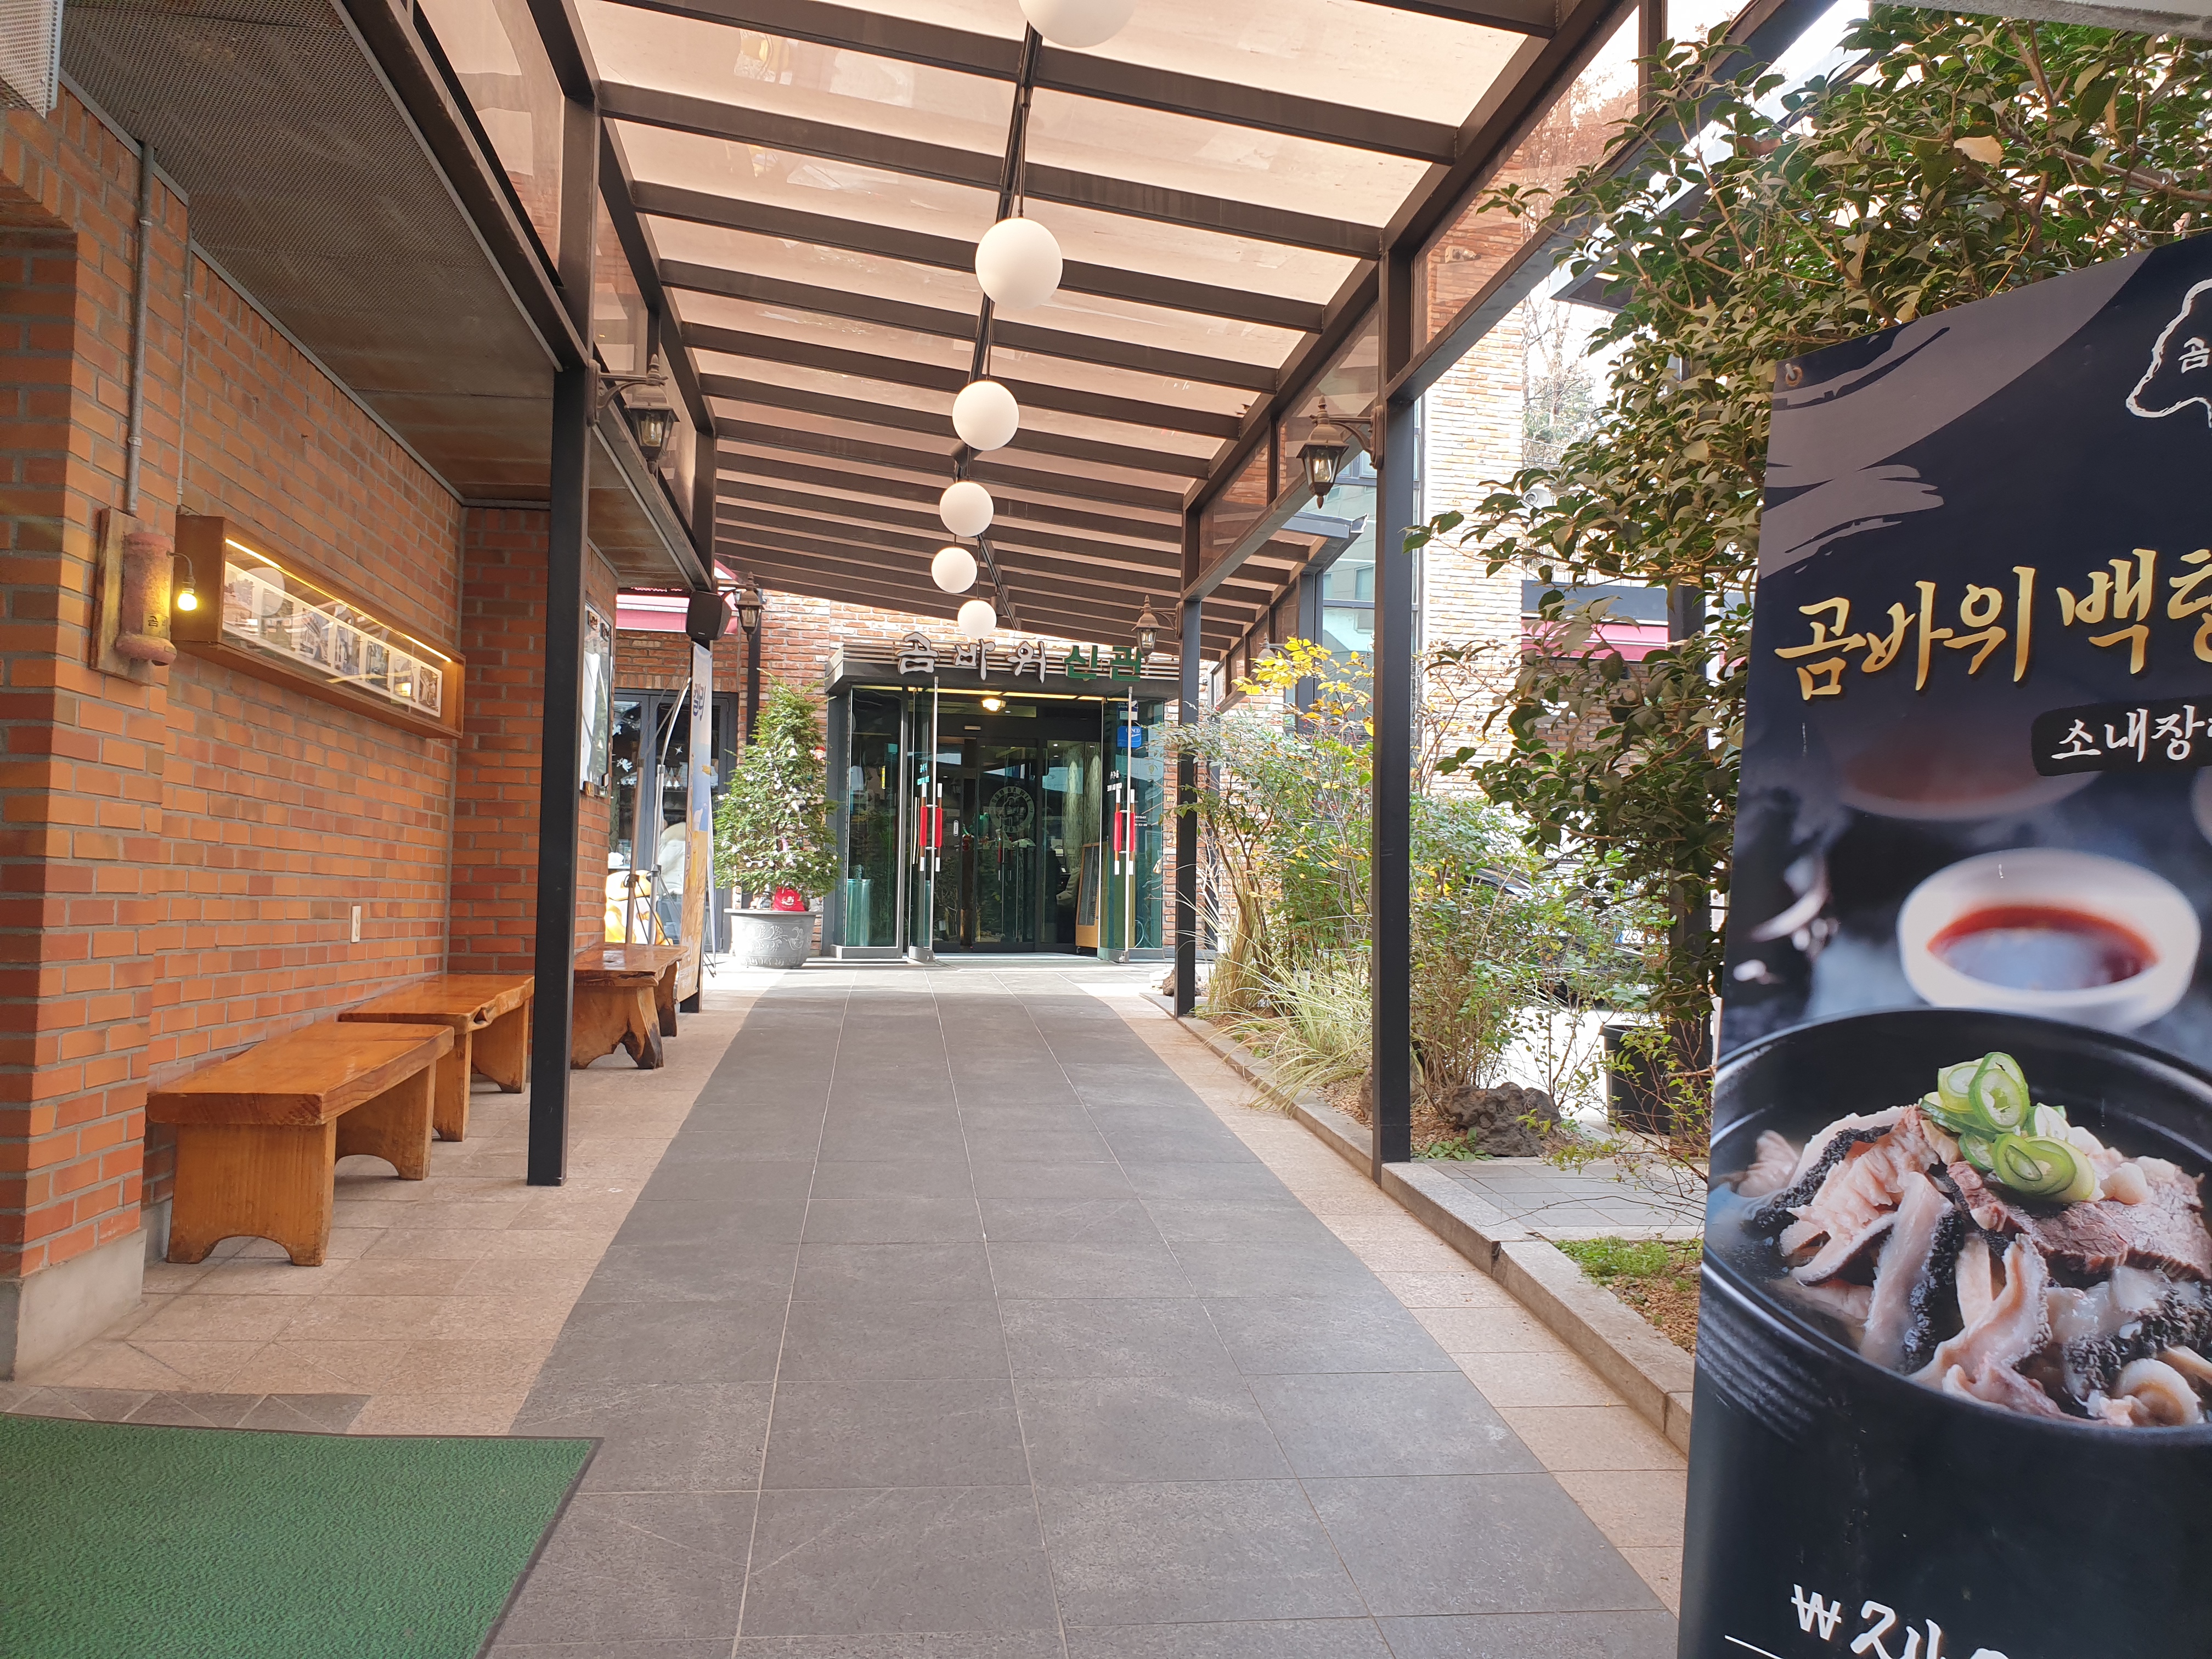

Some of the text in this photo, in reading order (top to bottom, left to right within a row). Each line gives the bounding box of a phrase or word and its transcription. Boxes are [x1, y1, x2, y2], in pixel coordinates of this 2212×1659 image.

[895, 631, 1141, 684] 곰바위 신관
[1774, 566, 2036, 700] 곰바위
[2051, 704, 2211, 763] 소내장
